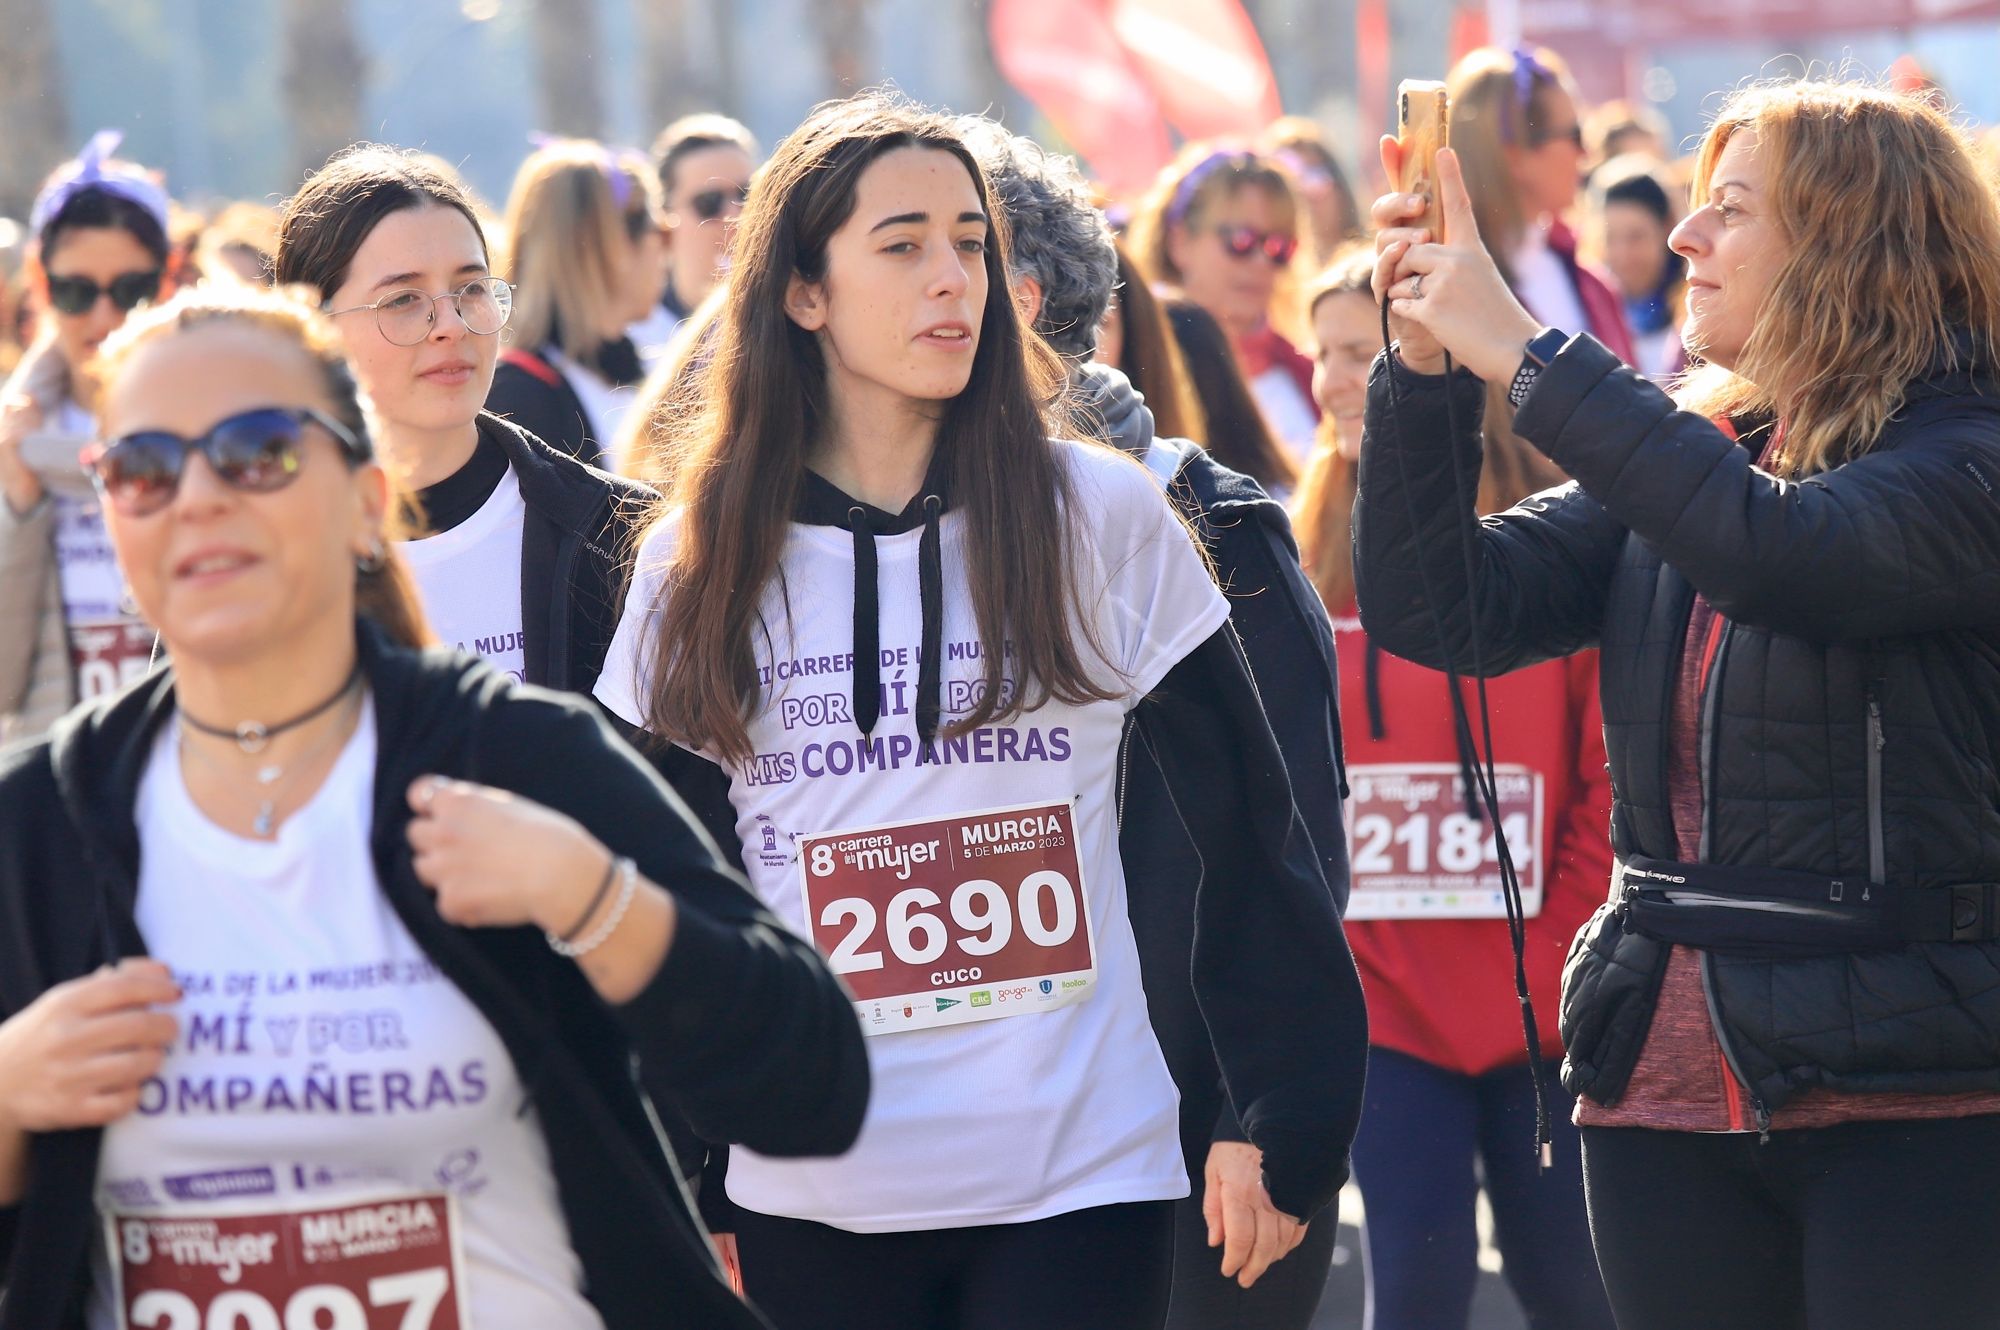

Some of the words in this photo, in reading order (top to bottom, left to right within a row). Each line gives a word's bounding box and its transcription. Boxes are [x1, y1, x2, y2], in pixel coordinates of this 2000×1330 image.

[583, 540, 616, 563] echua
[475, 632, 525, 656] MUJE
[777, 653, 854, 680] CARRER
[881, 648, 907, 667] DE
[782, 693, 852, 730] POR
[744, 752, 797, 787] MIS
[838, 834, 892, 852] carrera
[961, 814, 1062, 846] MURCIA
[964, 848, 972, 859] 5
[975, 845, 991, 857] DE
[993, 840, 1036, 855] MARZO
[1038, 836, 1066, 849] 2023
[1354, 813, 1533, 873] 2184
[856, 839, 940, 880] mujer
[819, 869, 1079, 975] 2690
[930, 966, 983, 986] CUCO
[187, 1000, 254, 1057] MÍ
[302, 1200, 438, 1244] MURCIA
[172, 1232, 278, 1285] mujer
